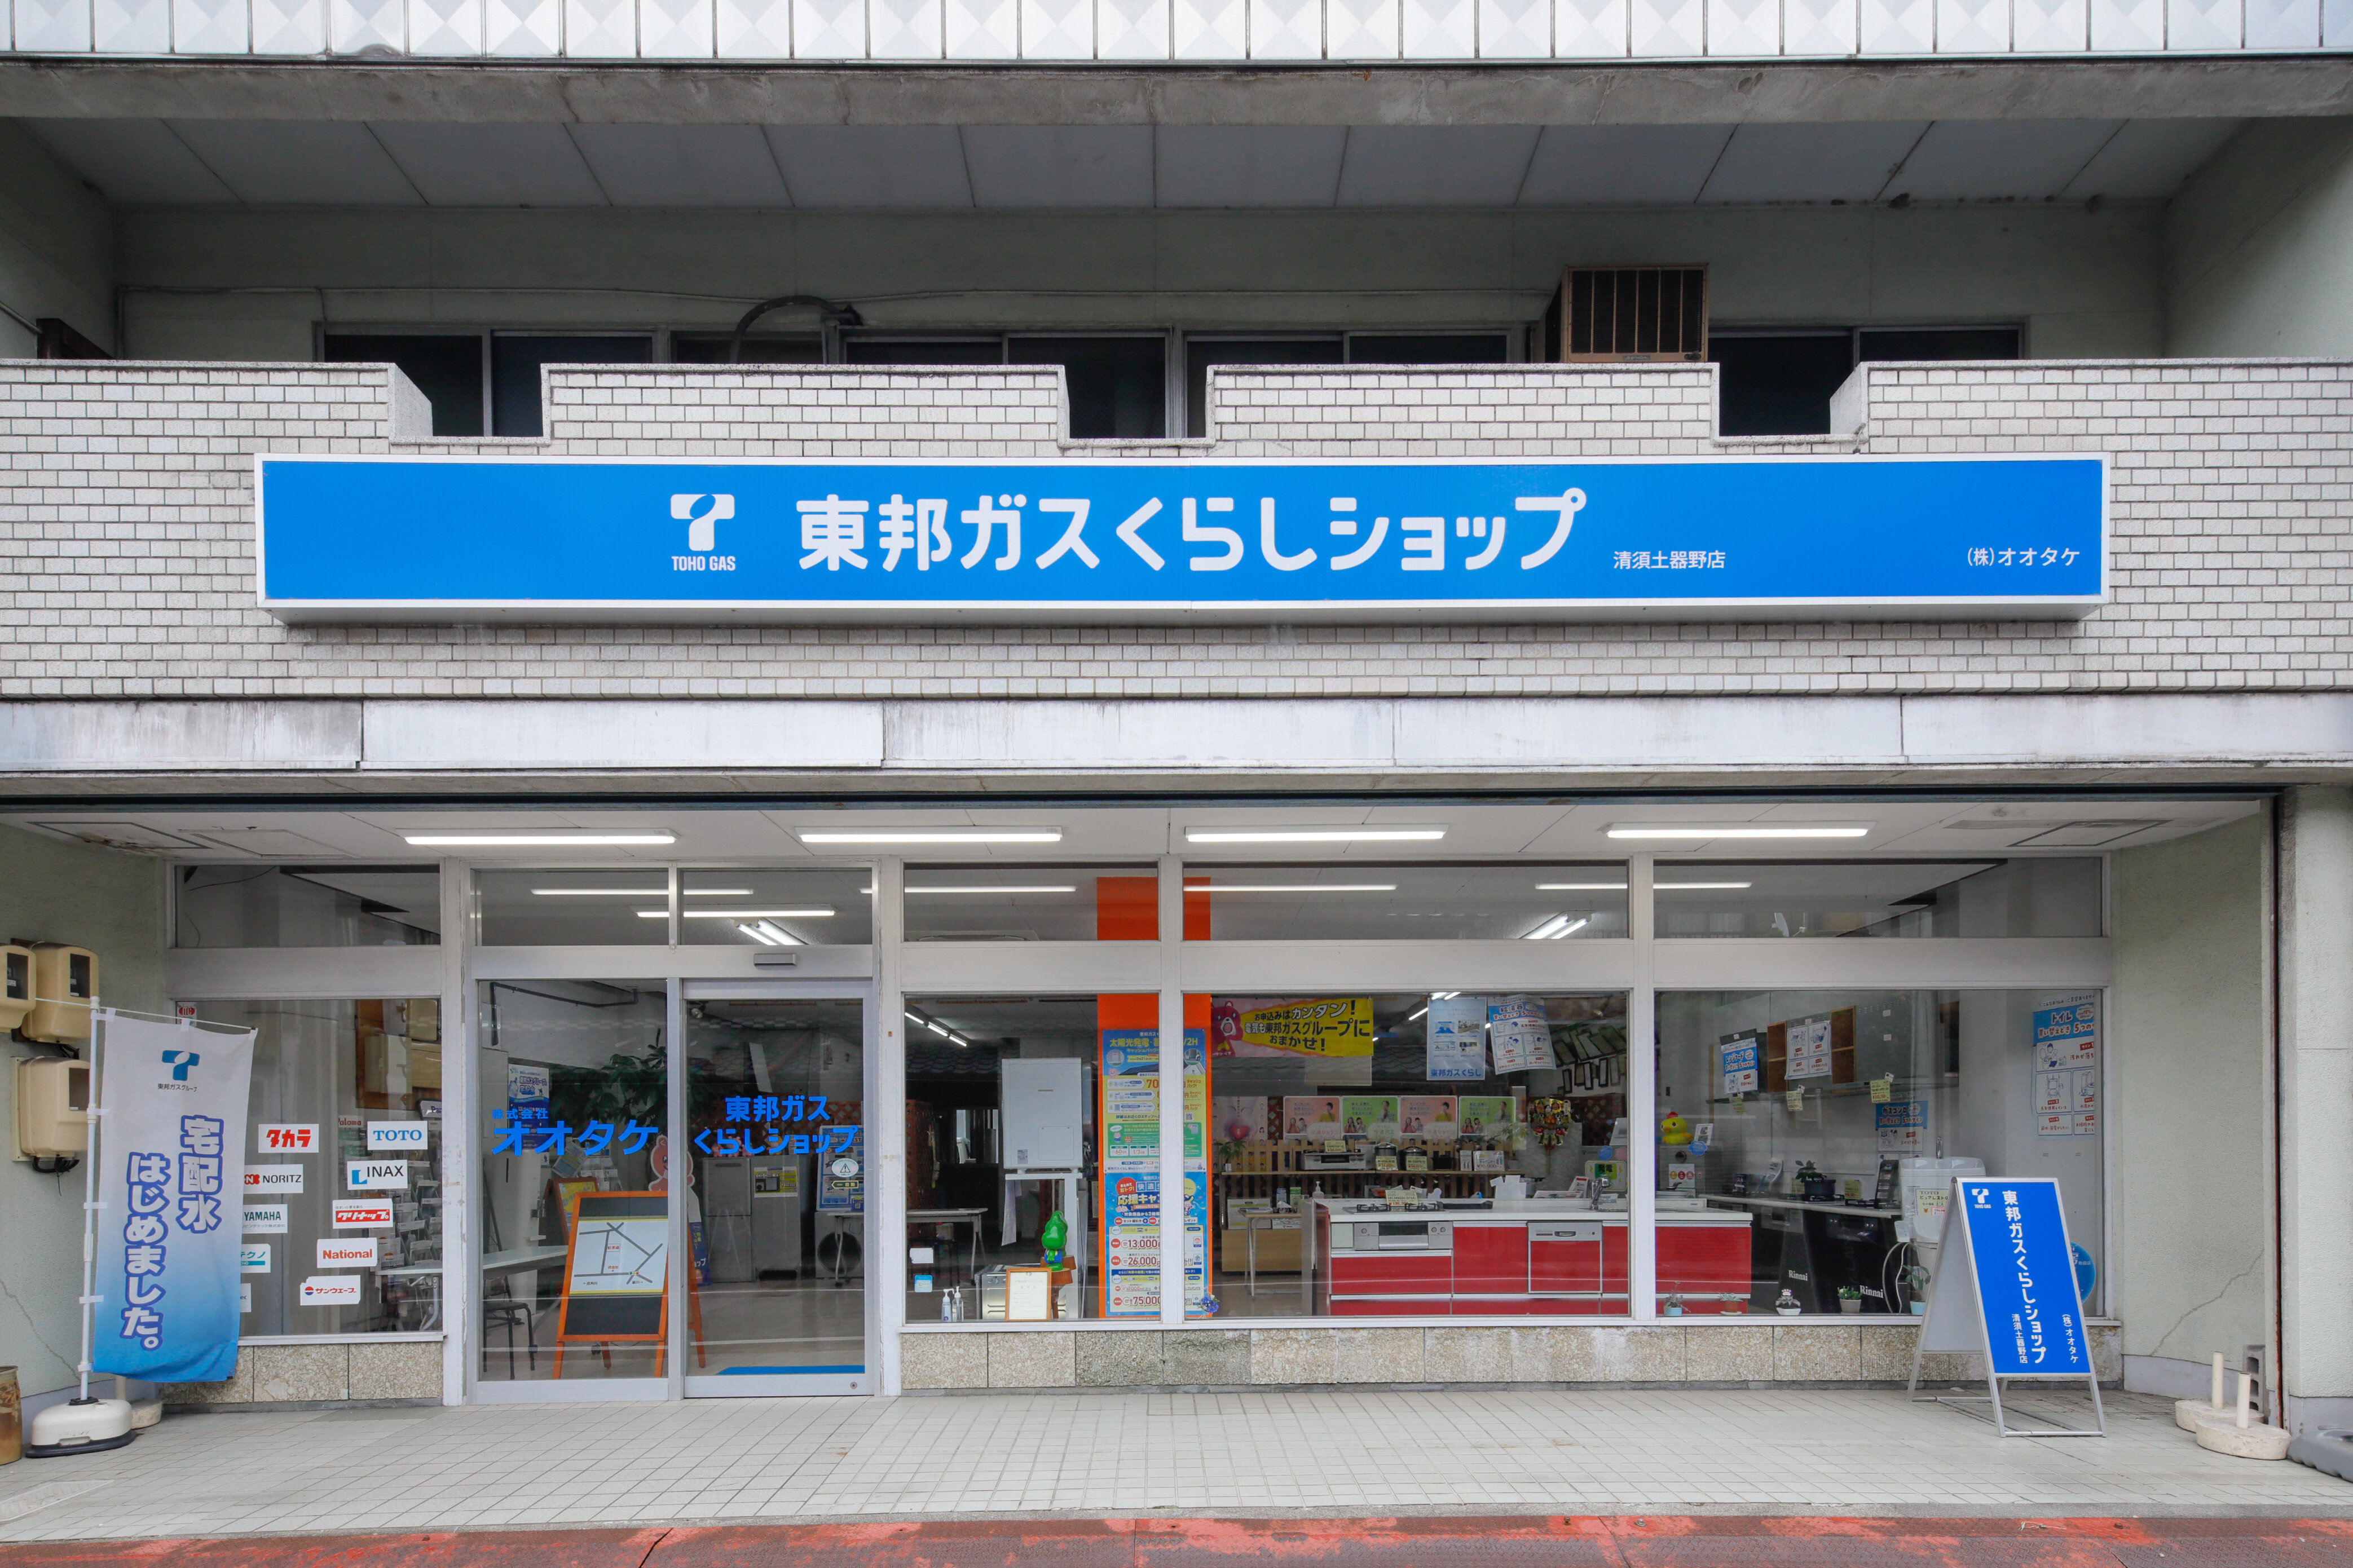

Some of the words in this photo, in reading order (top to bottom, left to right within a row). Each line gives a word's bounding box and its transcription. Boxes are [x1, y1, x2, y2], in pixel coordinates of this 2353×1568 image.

[796, 487, 1587, 572] 東邦ガスくらしショップ
[672, 556, 706, 571] TOHO
[709, 556, 736, 571] GAS
[1613, 550, 1725, 569] 清須土器野店
[1967, 547, 2080, 567] (株)オオタケ
[2043, 994, 2094, 1007] こんなお悩み・ご要望ありませ
[1255, 1000, 1356, 1021] お申込みはカンタン!
[2052, 1011, 2073, 1024] トイレ
[1245, 1018, 1371, 1037] 電気も東邦ガスグループに
[2038, 1026, 2071, 1038] 買い替えどき
[2074, 1022, 2094, 1033] 5つの
[1270, 1036, 1325, 1052] おまかせ!
[492, 1109, 548, 1120] 株式会社
[725, 1096, 831, 1122] 東邦ガス
[1882, 1106, 1907, 1115] ガスコンロ
[266, 1129, 311, 1147] タカラ
[373, 1129, 422, 1141] TOTO
[492, 1119, 659, 1156] オオタケ
[694, 1125, 858, 1155] くらしショップ
[177, 1115, 223, 1234] 宅配水
[367, 1165, 404, 1178] INAX
[1598, 1164, 1612, 1173] 発電
[263, 1174, 302, 1183] NORITZ
[244, 1211, 281, 1221] YAMAHA
[337, 1211, 389, 1221] クリナップ
[120, 1152, 170, 1351] はじめました。
[323, 1248, 372, 1260] National
[1788, 1270, 1808, 1281] Rinnai
[2003, 1190, 2046, 1364] 東邦ガスくらしショップ
[1860, 1285, 1884, 1298] Rinnai
[2012, 1314, 2028, 1364] 清須土器野店
[2062, 1314, 2078, 1363] (株)オオタケ
